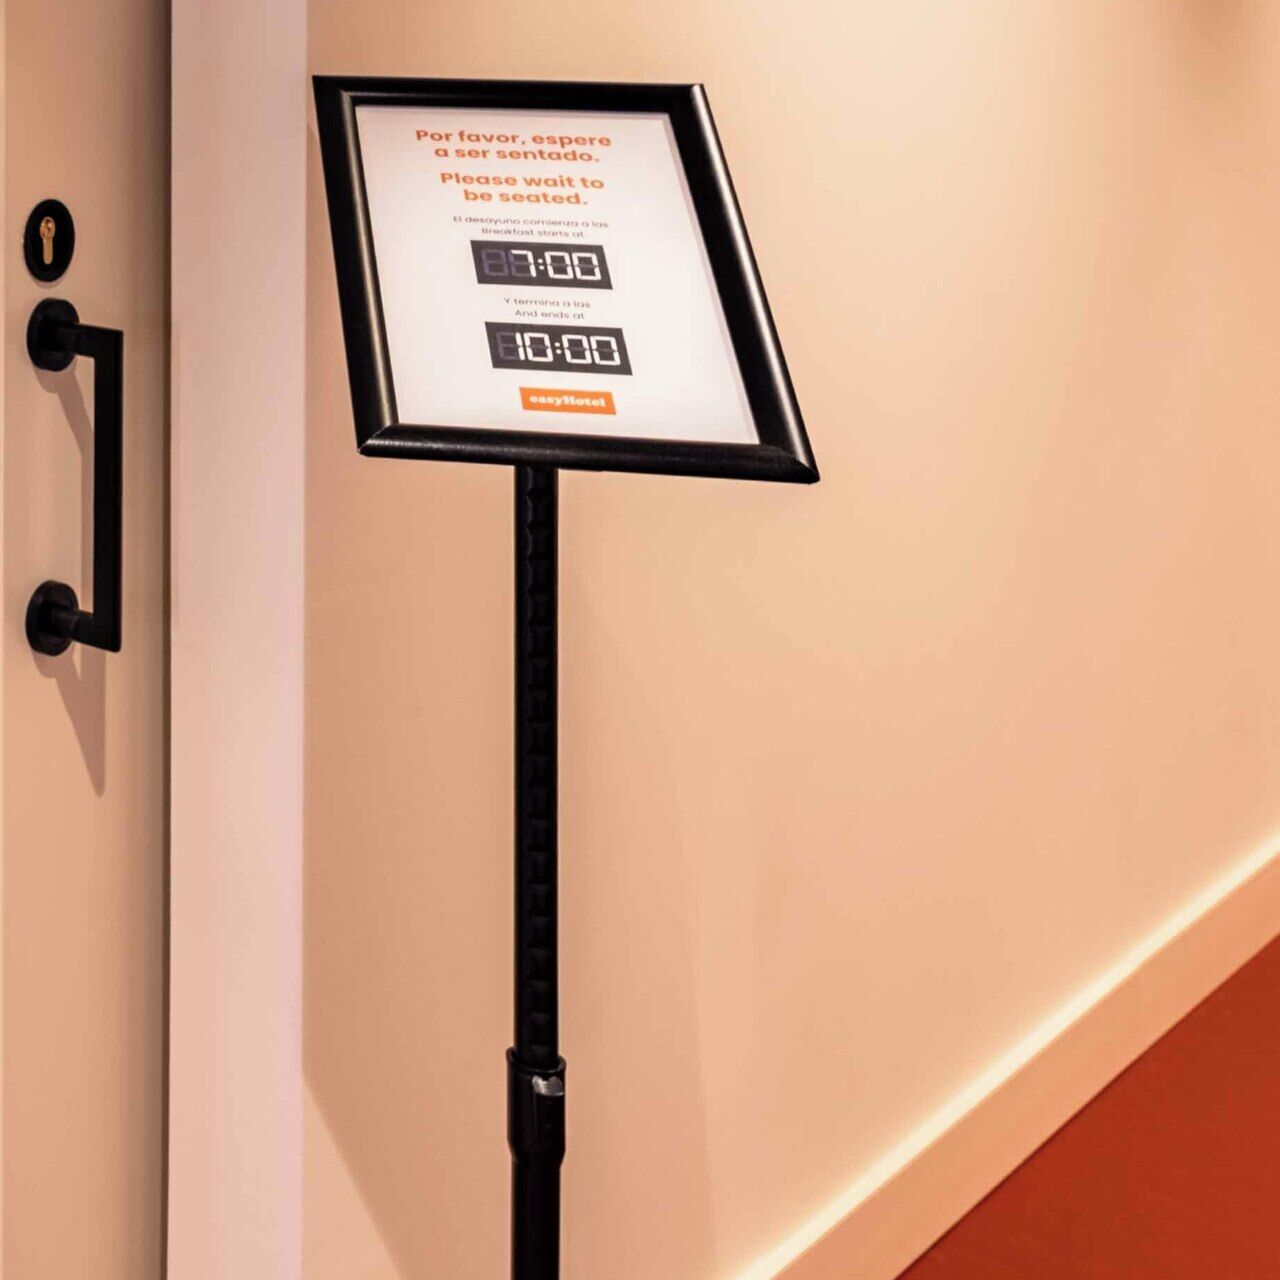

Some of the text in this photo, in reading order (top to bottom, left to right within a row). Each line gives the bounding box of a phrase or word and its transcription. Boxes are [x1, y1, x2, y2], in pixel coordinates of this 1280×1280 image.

[415, 129, 612, 148] Por favor, espere
[434, 147, 600, 162] a ser sentado.
[440, 172, 605, 189] Please wait to
[463, 189, 588, 206] be seated.
[465, 216, 521, 226] desayuno
[523, 218, 579, 227] comienza
[592, 220, 609, 228] las
[481, 227, 585, 238] Breakfast starts at
[510, 249, 602, 281] 7:00
[513, 298, 560, 307] termina
[573, 299, 591, 309] las
[515, 309, 585, 320] And ends at
[515, 331, 621, 366] 10:00
[528, 394, 607, 407] easyHotel
